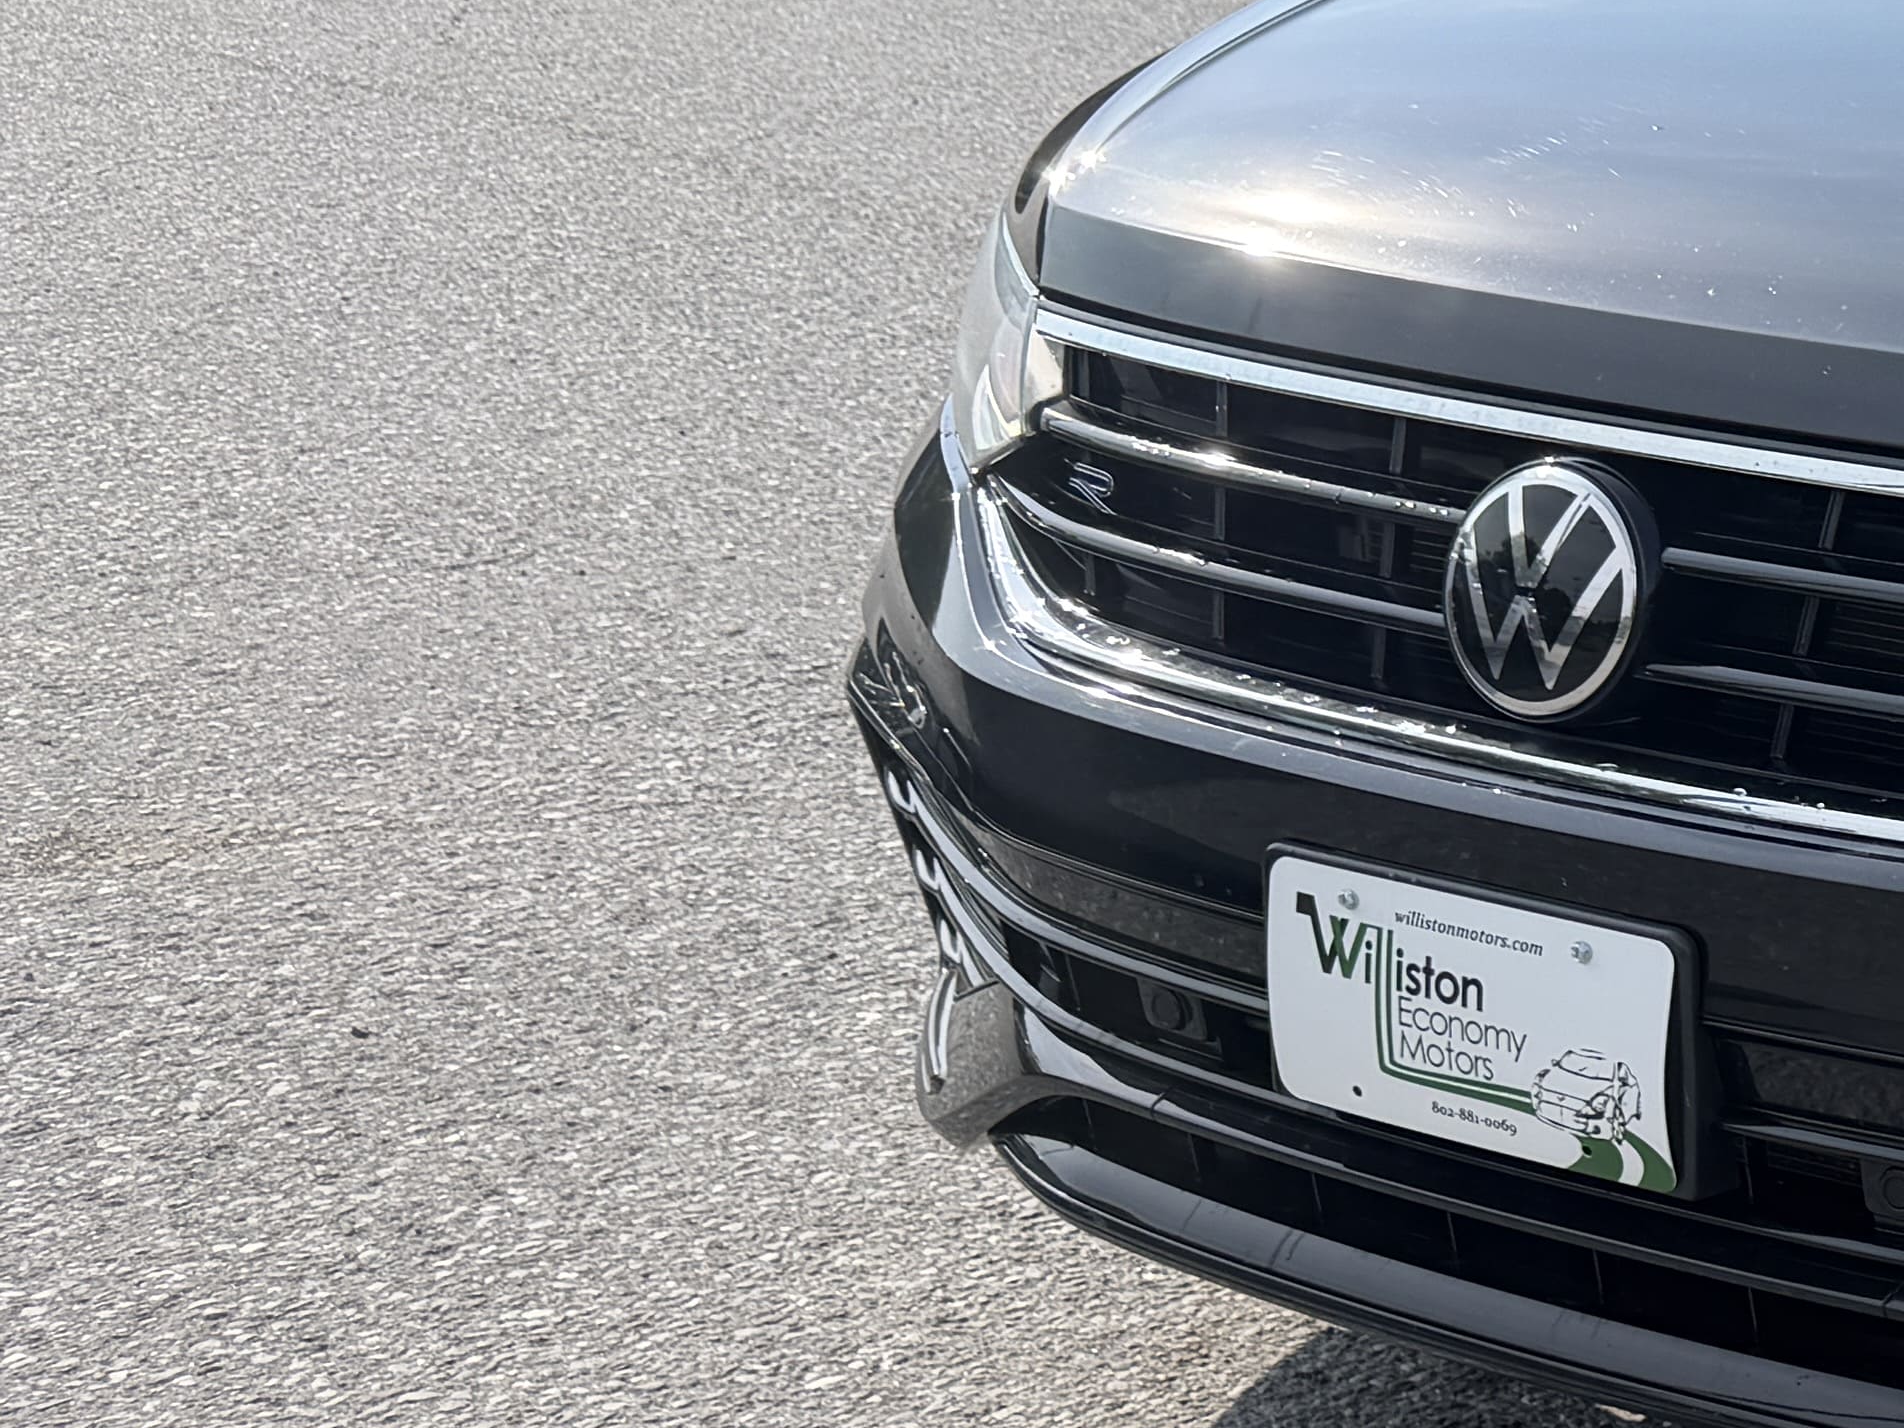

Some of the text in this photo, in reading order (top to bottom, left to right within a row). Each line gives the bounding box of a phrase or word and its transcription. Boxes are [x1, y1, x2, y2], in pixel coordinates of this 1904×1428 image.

[1295, 891, 1484, 1014] Williston
[1395, 911, 1543, 956] willistonmotors.com
[1398, 995, 1527, 1062] Economy
[1399, 1030, 1495, 1082] Motors
[1431, 1101, 1517, 1136] 802-881-0069
